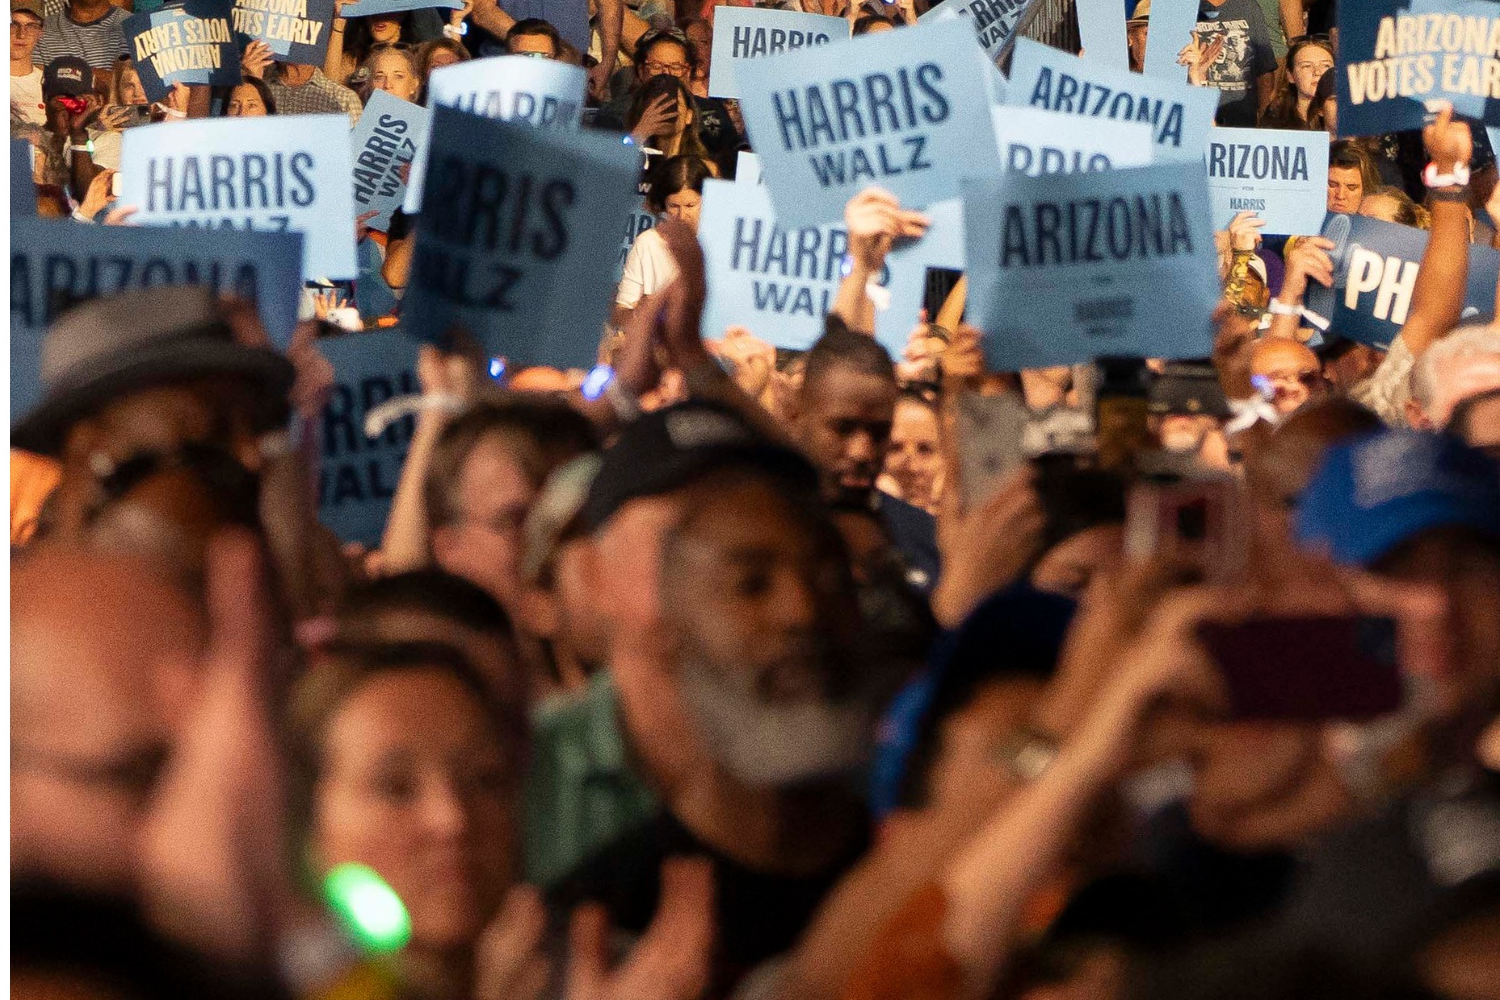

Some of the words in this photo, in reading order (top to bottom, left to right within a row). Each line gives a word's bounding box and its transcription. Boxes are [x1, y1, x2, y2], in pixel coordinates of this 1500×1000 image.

[134, 23, 180, 62] EARLY
[182, 17, 233, 44] VOTES
[231, 7, 270, 37] OTES
[265, 14, 324, 46] EARLY
[150, 41, 222, 74] ARIZONA
[1347, 53, 1435, 106] VOTES
[771, 62, 951, 154] HARRIS
[807, 134, 933, 190] WALZ
[1206, 142, 1309, 181] RIZONA
[147, 150, 317, 213] HARRIS
[1229, 198, 1266, 210] HARRIS
[999, 190, 1194, 269] ARIZONA
